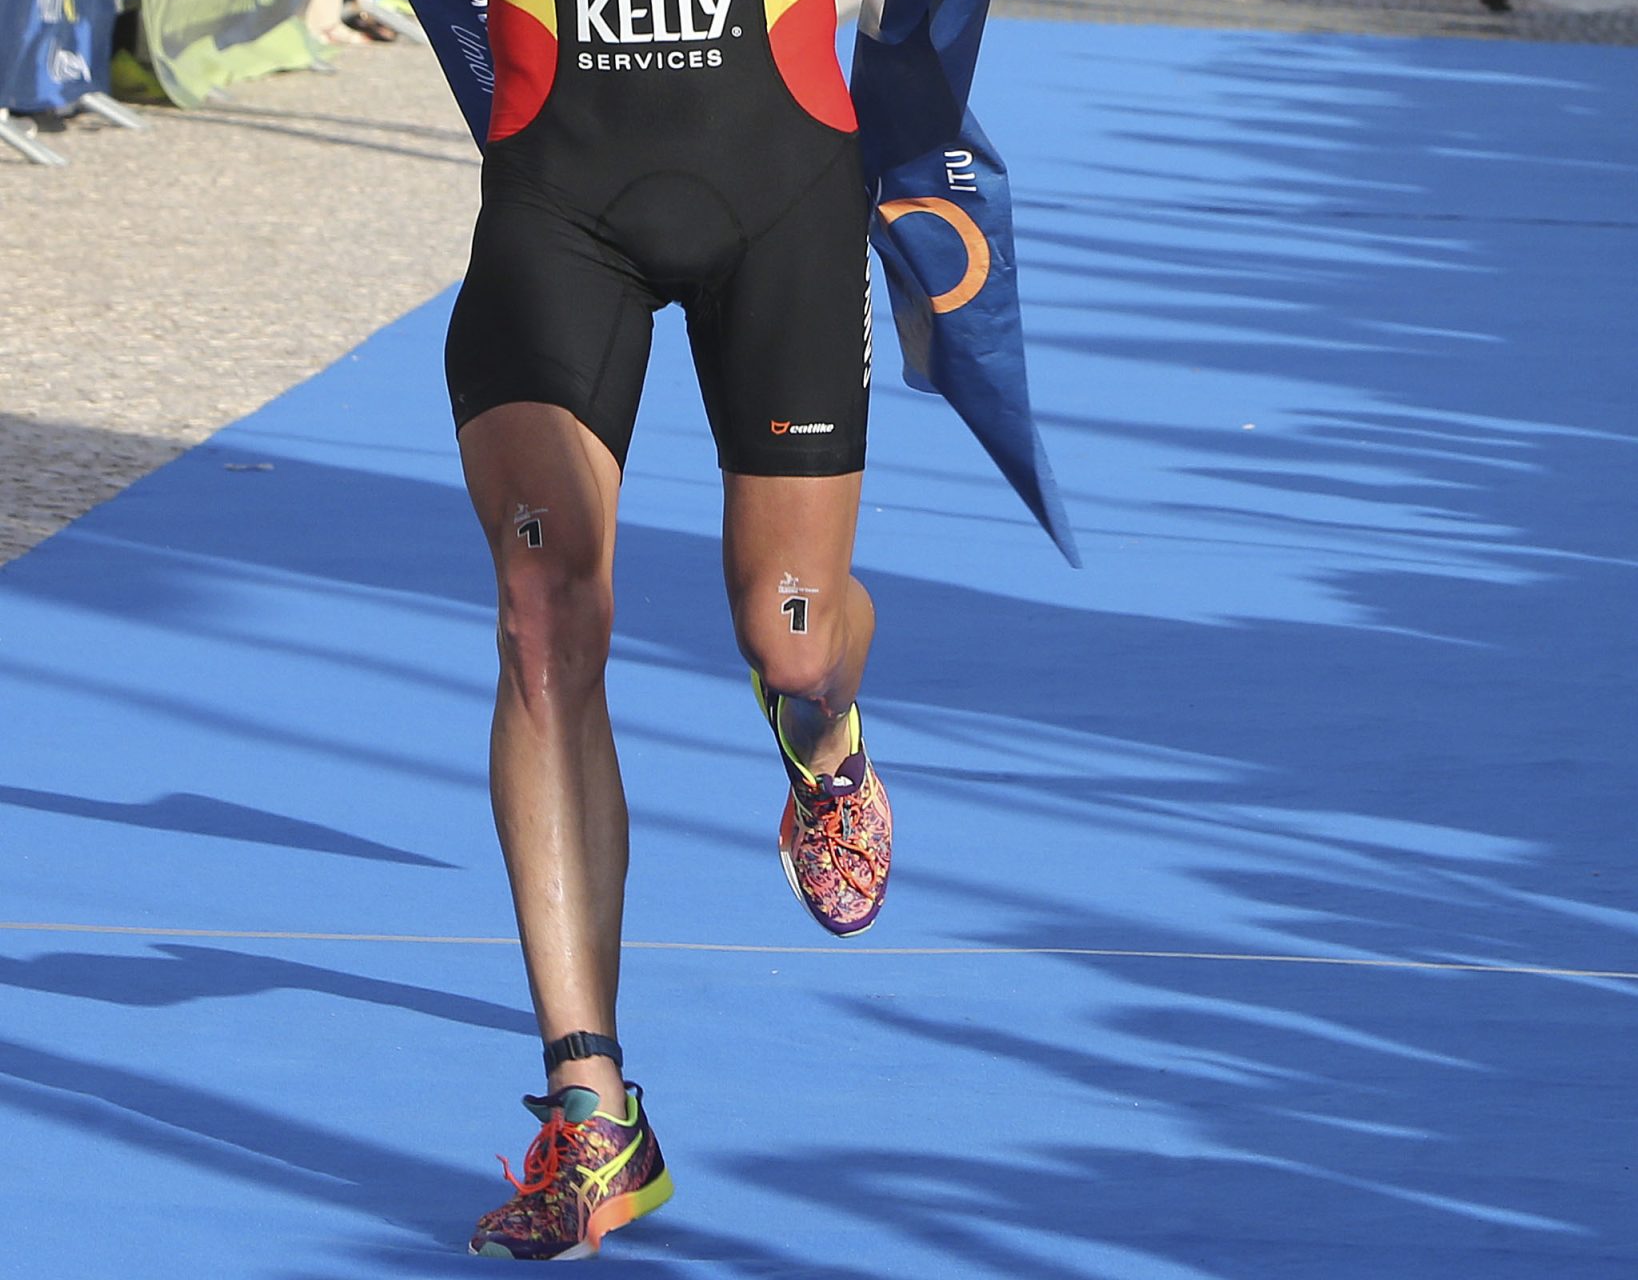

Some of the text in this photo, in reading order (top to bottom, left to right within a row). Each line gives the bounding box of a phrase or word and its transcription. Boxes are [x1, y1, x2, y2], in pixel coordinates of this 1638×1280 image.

[577, 48, 723, 71] SERVICES
[943, 149, 978, 193] ITU
[516, 518, 543, 549] 1
[781, 595, 809, 635] 1
